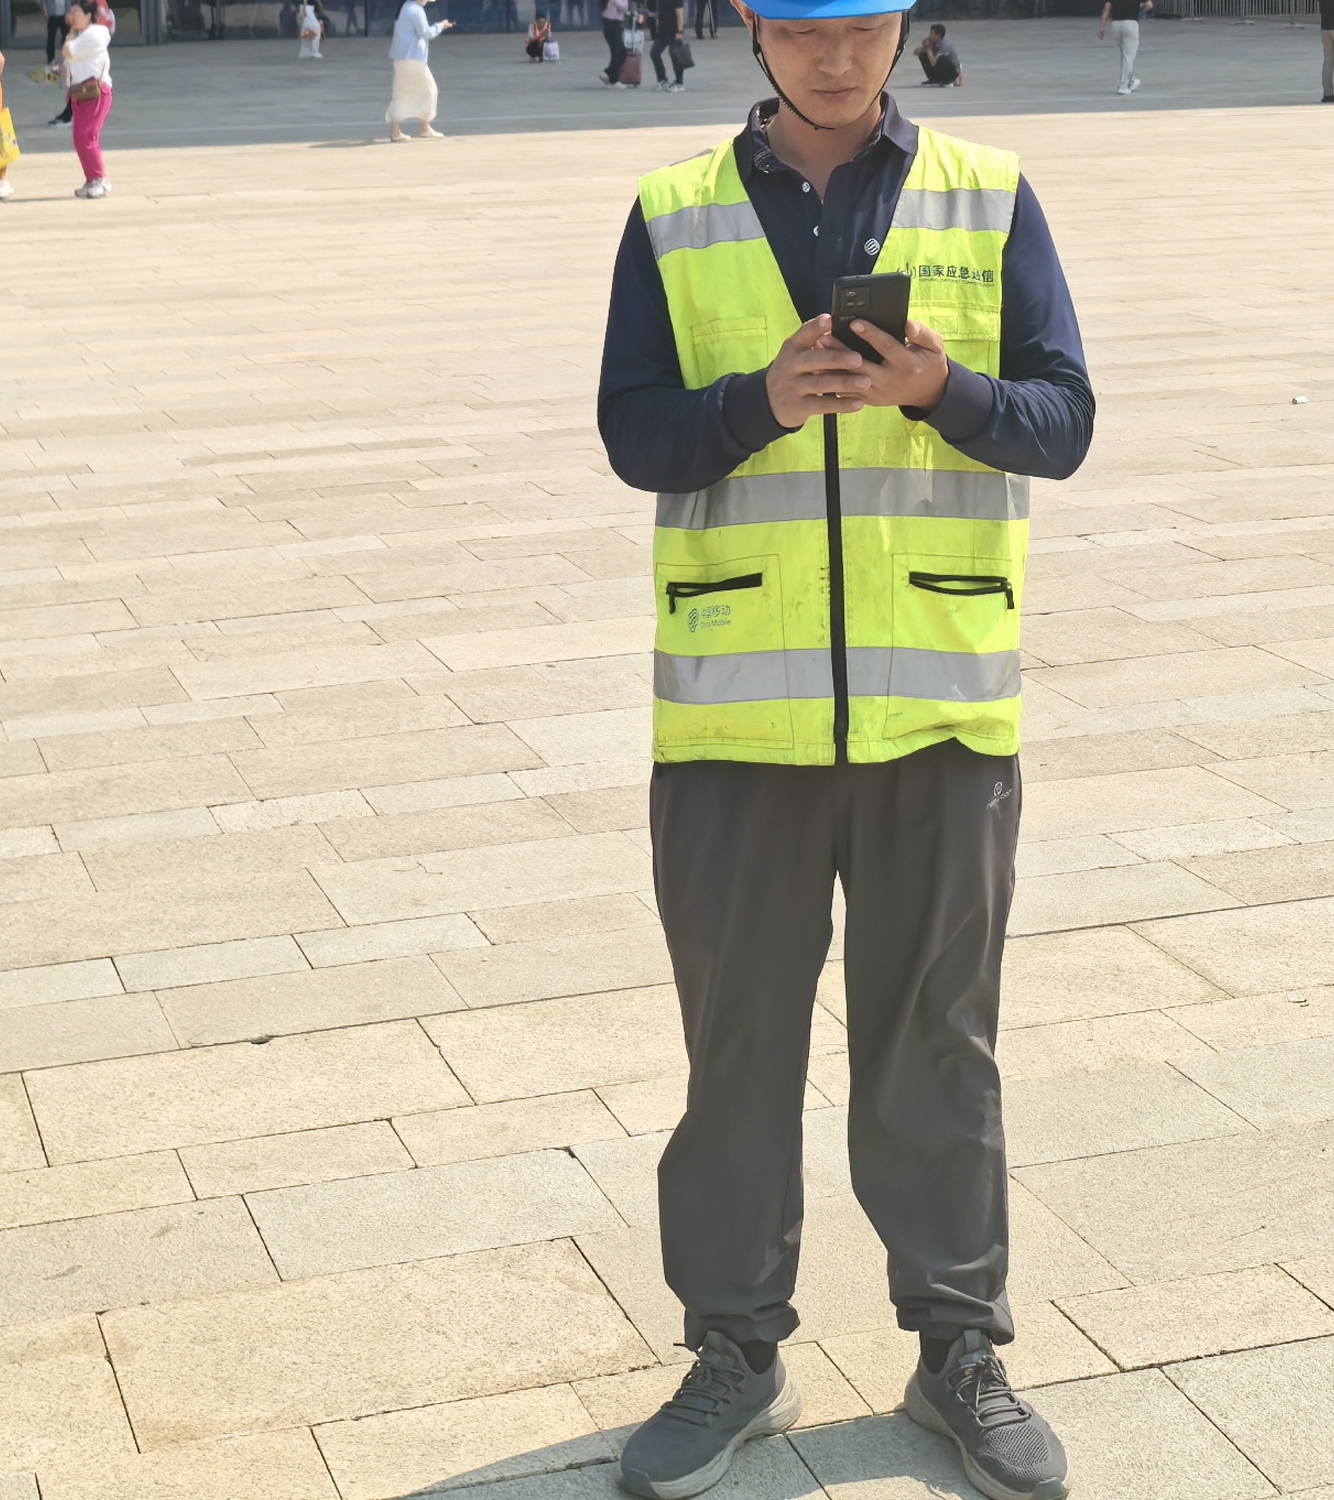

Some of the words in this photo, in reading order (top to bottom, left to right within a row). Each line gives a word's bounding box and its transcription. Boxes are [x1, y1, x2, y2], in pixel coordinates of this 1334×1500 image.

[919, 264, 994, 283] 国家应急通信
